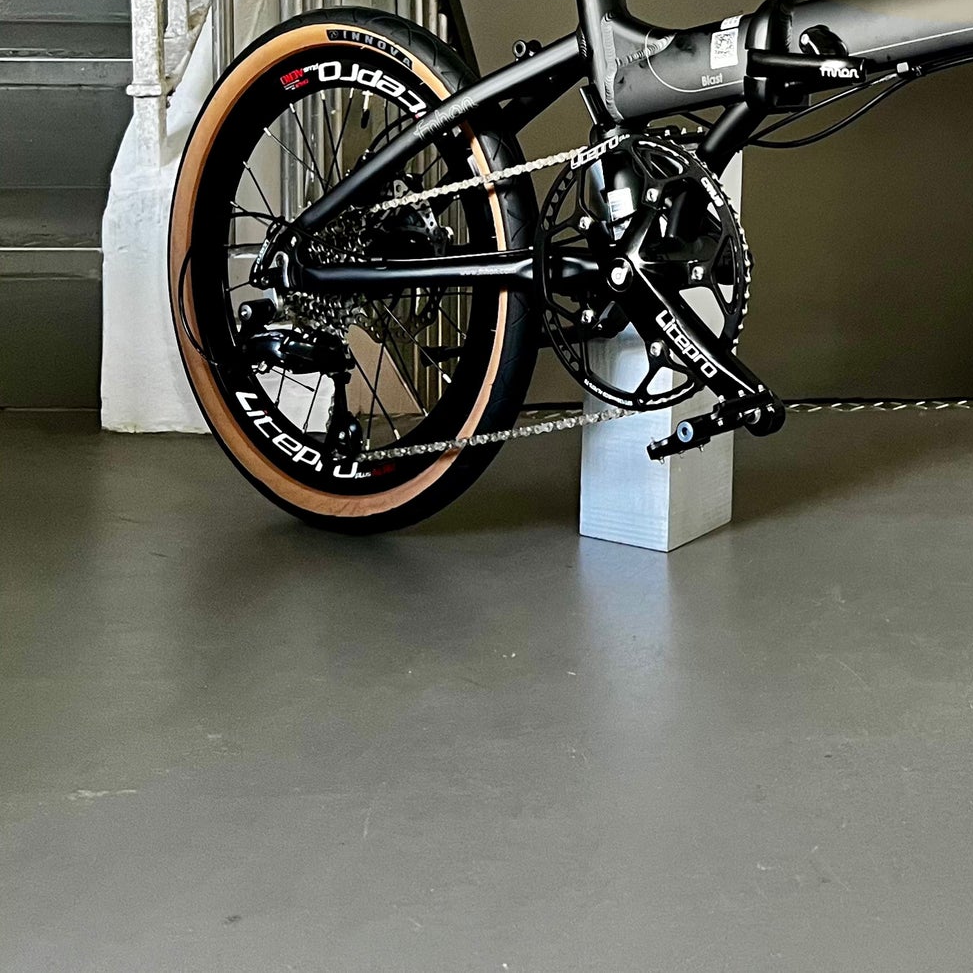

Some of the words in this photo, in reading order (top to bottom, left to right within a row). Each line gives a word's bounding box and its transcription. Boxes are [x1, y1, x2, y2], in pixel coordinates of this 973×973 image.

[343, 30, 412, 68] INNOVA
[701, 72, 723, 87] Blast
[413, 96, 478, 140] fnhon
